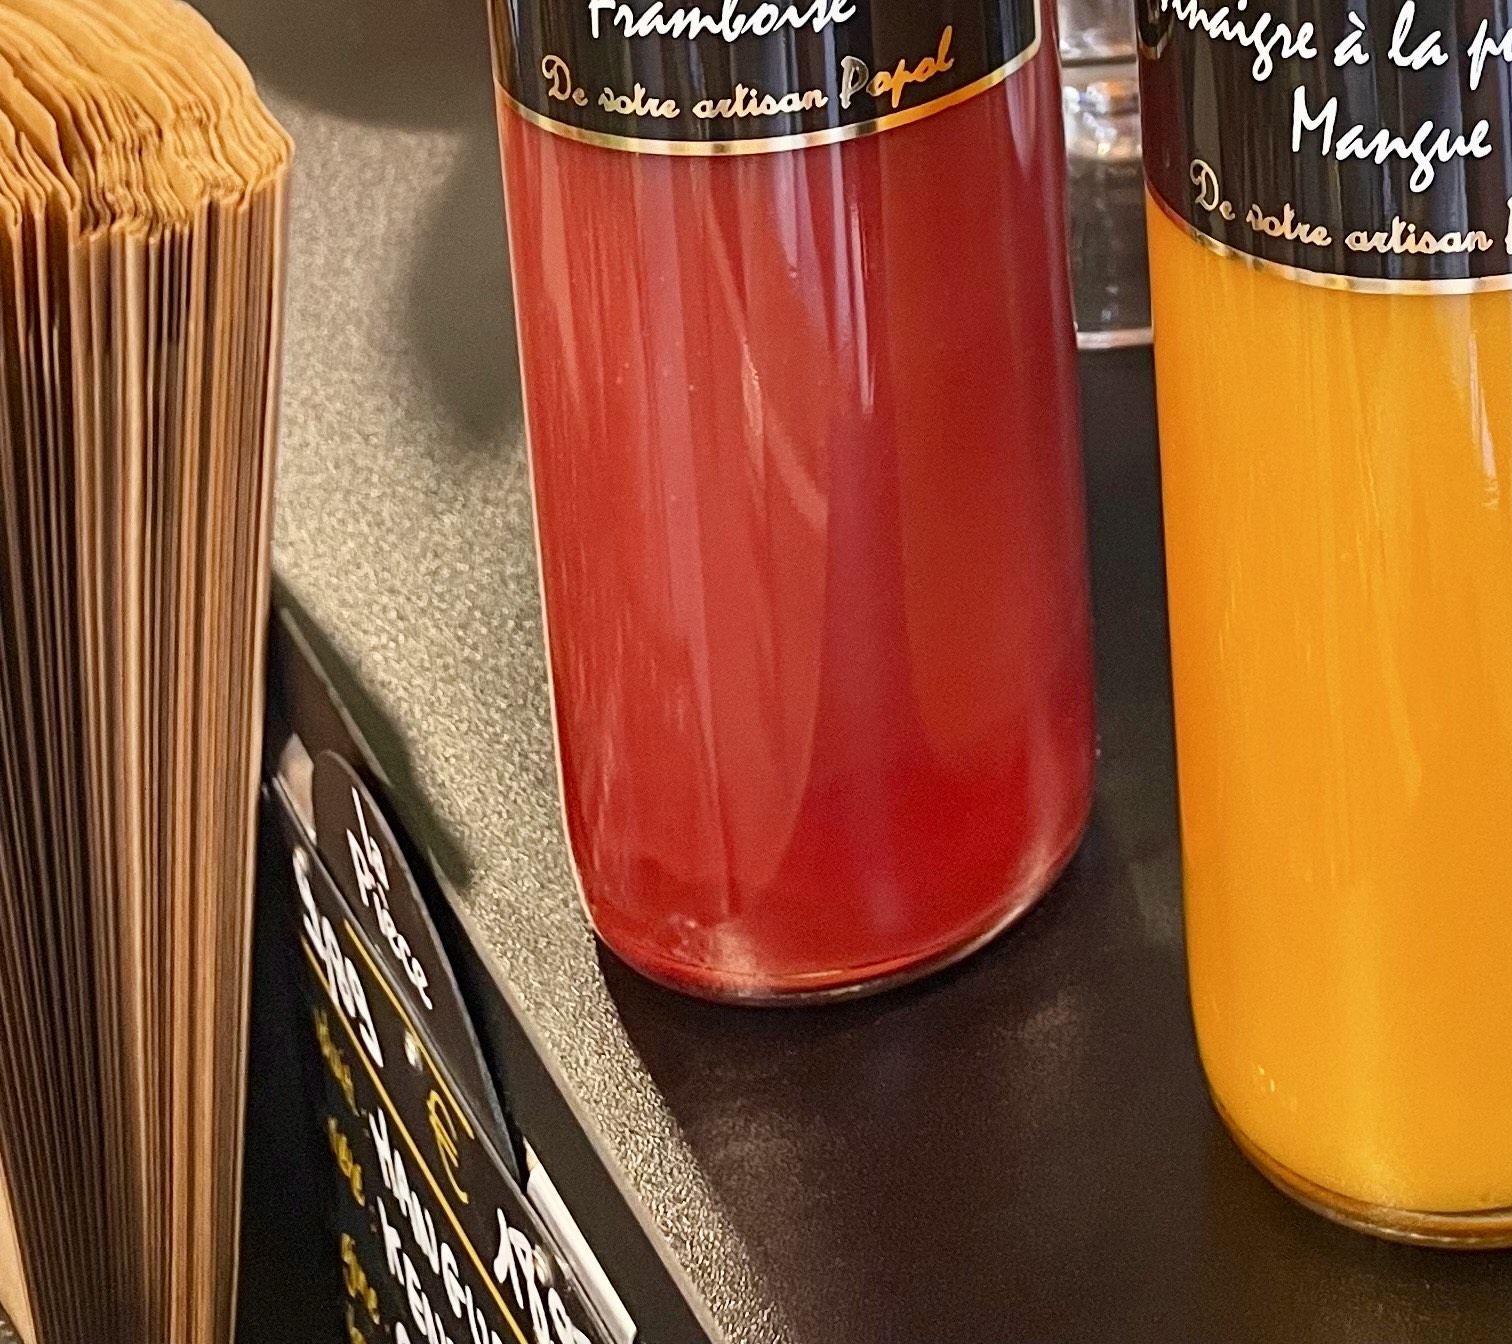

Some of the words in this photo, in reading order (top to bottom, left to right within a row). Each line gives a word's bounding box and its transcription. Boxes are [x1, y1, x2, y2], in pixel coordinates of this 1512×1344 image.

[541, 54, 588, 106] De
[692, 82, 829, 119] artisan
[839, 24, 955, 109] Popol
[1333, 11, 1369, 67] à
[1388, 0, 1449, 68] la
[1290, 85, 1493, 193] Mangue
[1189, 159, 1236, 222] De
[1344, 215, 1494, 255] artisan
[426, 1089, 469, 1205] €
